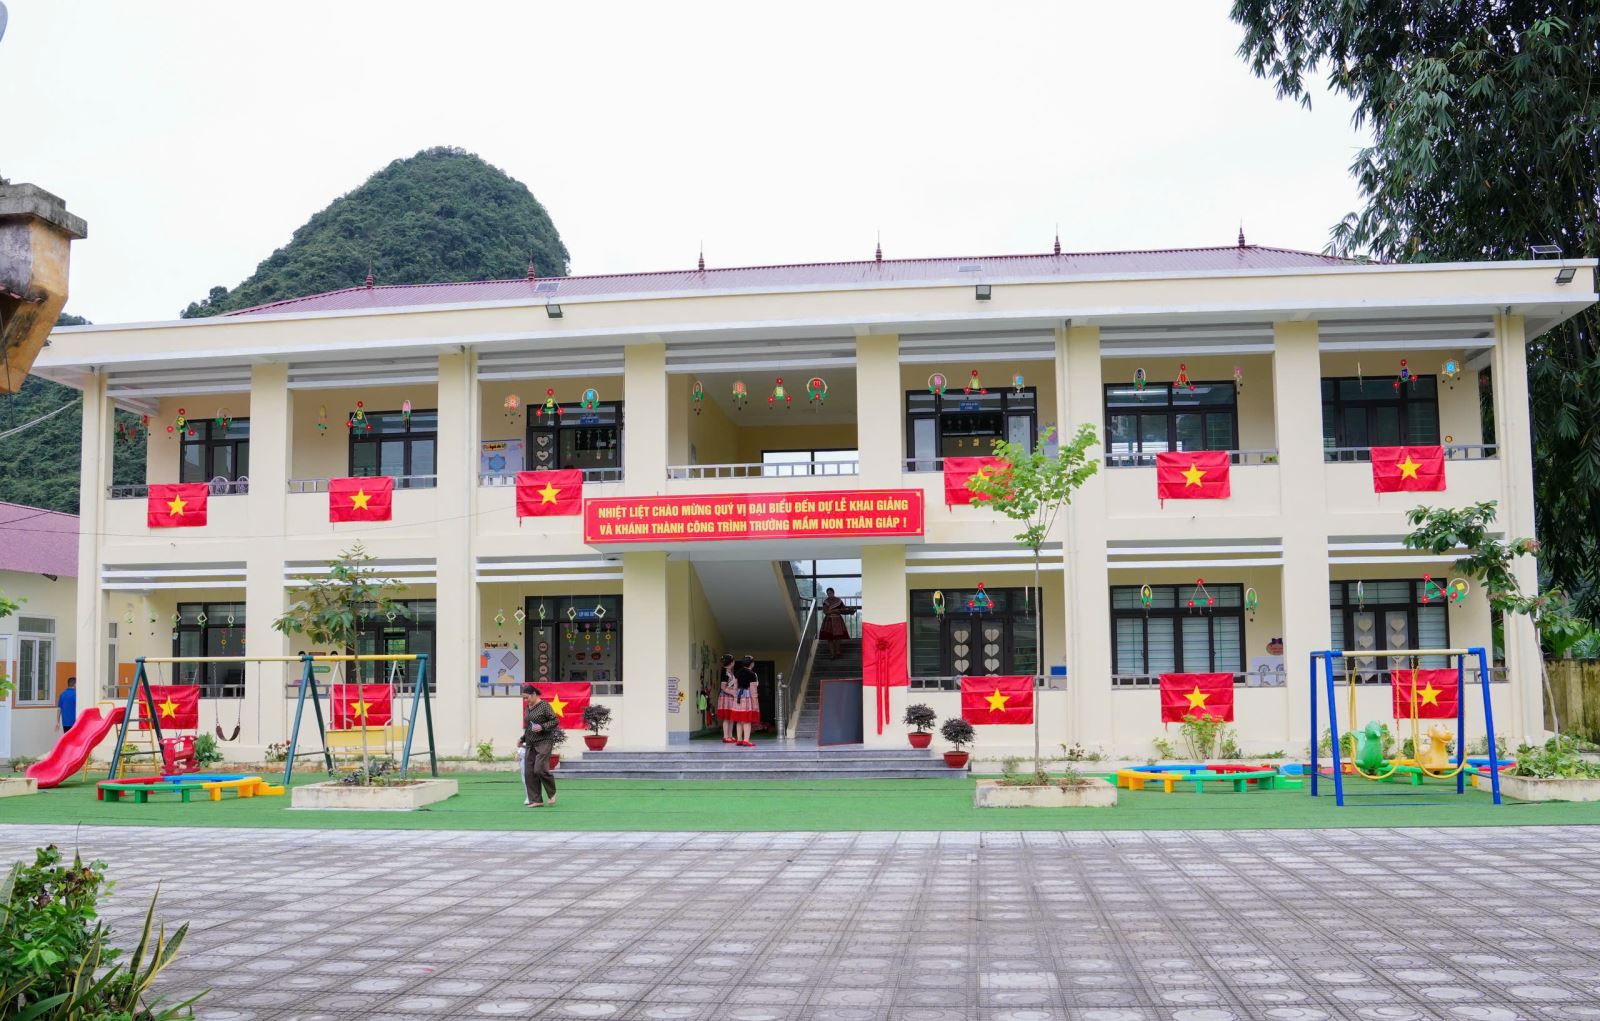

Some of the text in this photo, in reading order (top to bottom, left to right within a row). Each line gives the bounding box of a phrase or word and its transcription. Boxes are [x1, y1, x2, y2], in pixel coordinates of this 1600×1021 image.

[598, 496, 909, 520] NHIỆT LIỆT CHÀO MỪNG QUÝ VỊ ĐẠI BIỂU ĐẾN DỰ LỄ KHAI GIẢNG
[599, 522, 613, 535] VÀ
[615, 522, 649, 535] KHÁNH
[651, 521, 684, 534] THÀNH
[686, 520, 715, 533] CÔNG
[717, 519, 747, 532] TRÌNH
[749, 517, 789, 531] TRƯỜNG
[820, 518, 844, 530] NON
[875, 515, 900, 528] GIÁP
[903, 516, 907, 528] !
